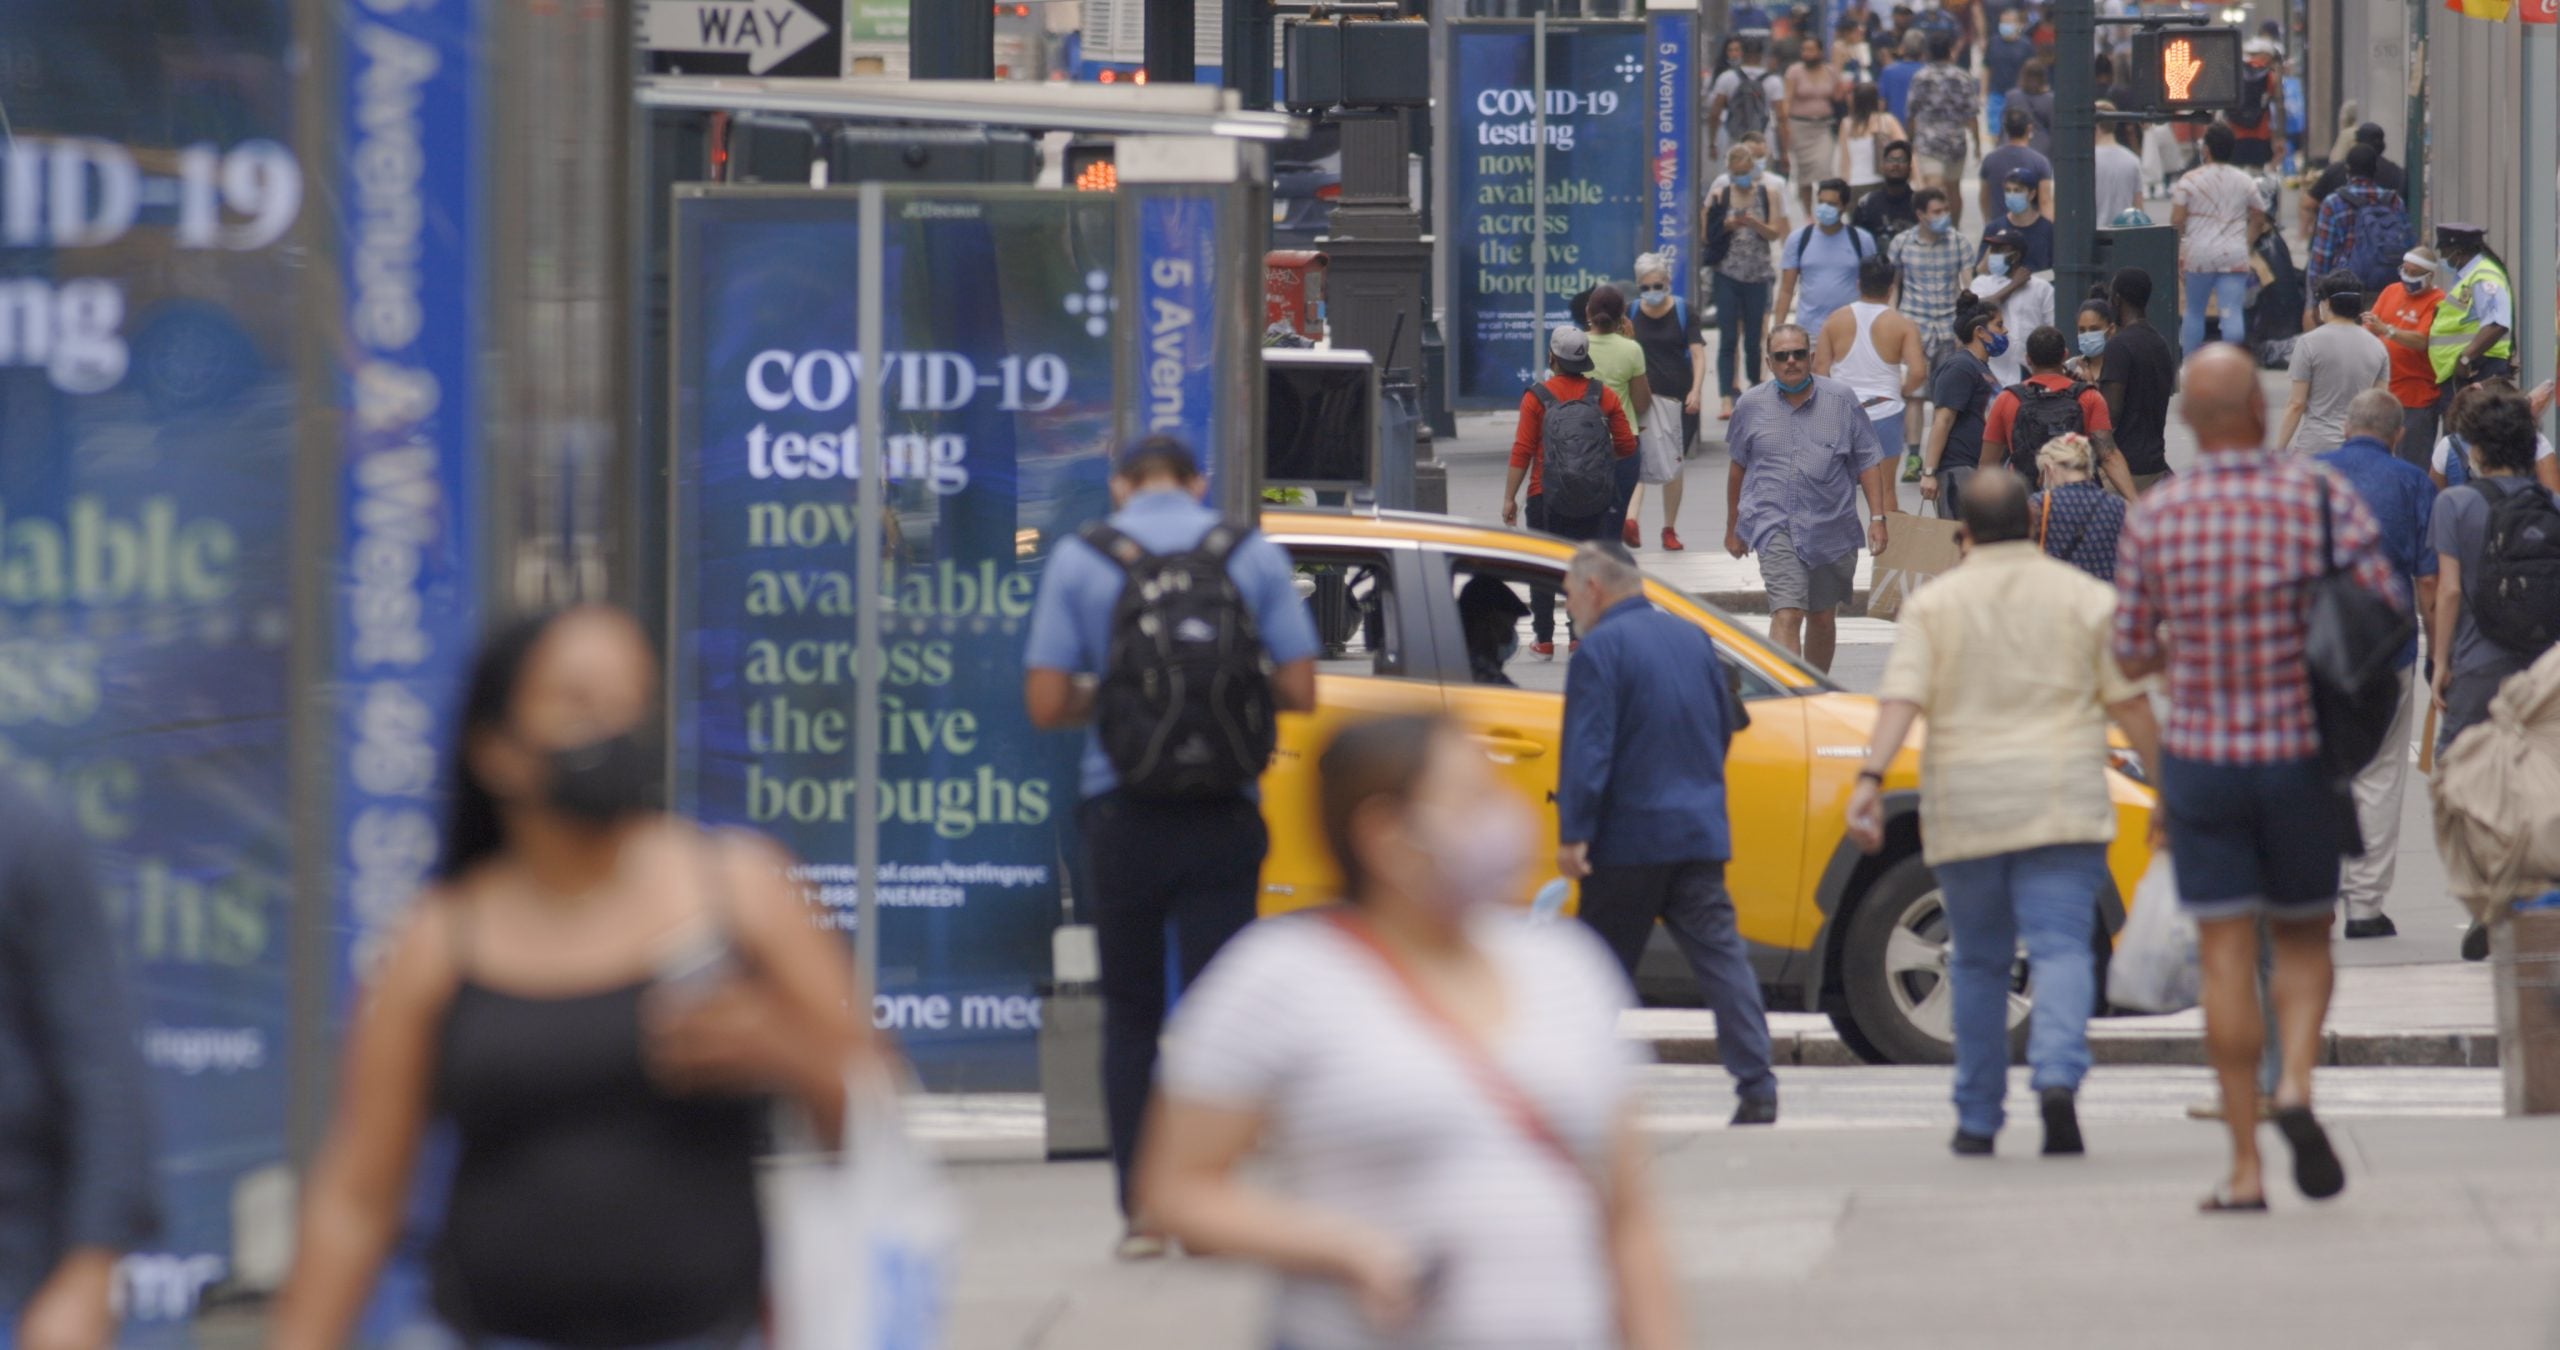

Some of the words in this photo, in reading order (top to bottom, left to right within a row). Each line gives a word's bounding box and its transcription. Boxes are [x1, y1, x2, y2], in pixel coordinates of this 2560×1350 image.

[697, 7, 794, 47] WAY
[1660, 43, 1677, 55] 5
[1477, 89, 1619, 116] COVID-19
[1660, 60, 1677, 133] Avenue
[1477, 118, 1575, 151] testing
[1660, 138, 1677, 154] &
[352, 20, 442, 350] Avenue
[1477, 178, 1603, 205] avaiable
[1660, 157, 1677, 210] West
[1477, 213, 1569, 235] across
[1660, 214, 1676, 238] 44
[1478, 238, 1522, 264] the
[1152, 258, 1195, 288] 5
[746, 423, 969, 495] testng
[0, 494, 240, 606] able
[745, 558, 1033, 616] avalable
[747, 695, 845, 754] the
[873, 995, 950, 1029] one
